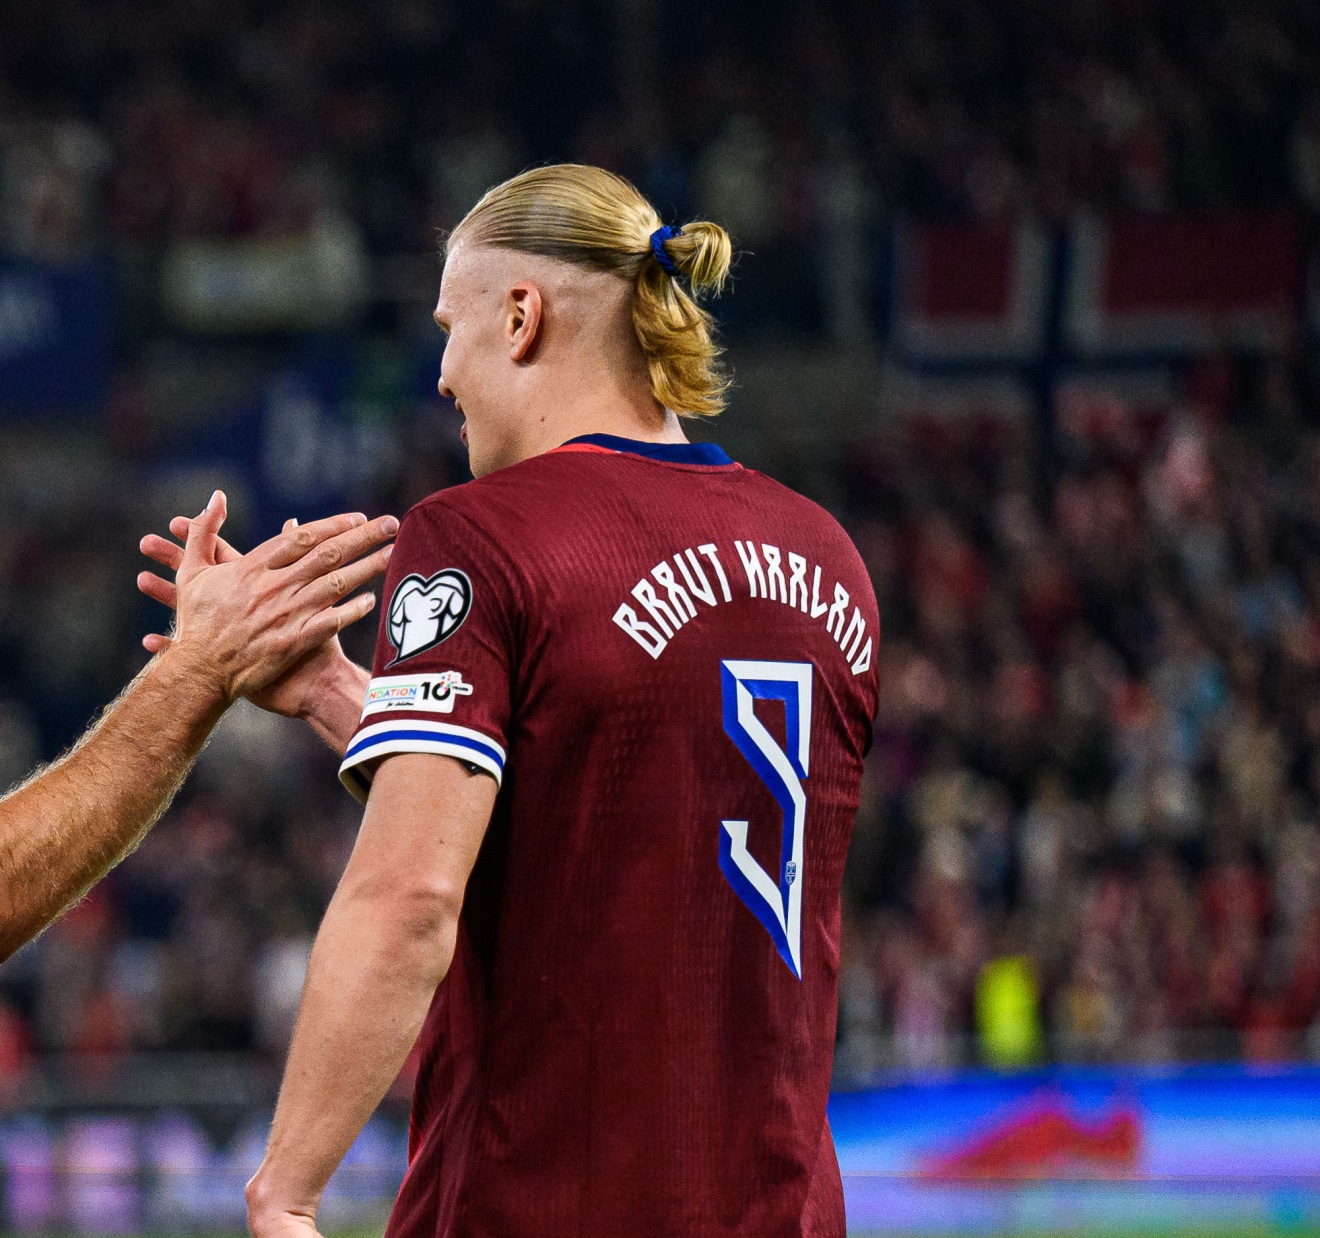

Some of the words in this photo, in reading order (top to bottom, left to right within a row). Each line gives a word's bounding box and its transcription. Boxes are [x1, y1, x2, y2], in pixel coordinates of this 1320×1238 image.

[612, 543, 732, 660] BRAUT
[734, 540, 873, 676] HAALAND
[420, 681, 451, 701] 10
[718, 658, 813, 983] 9
